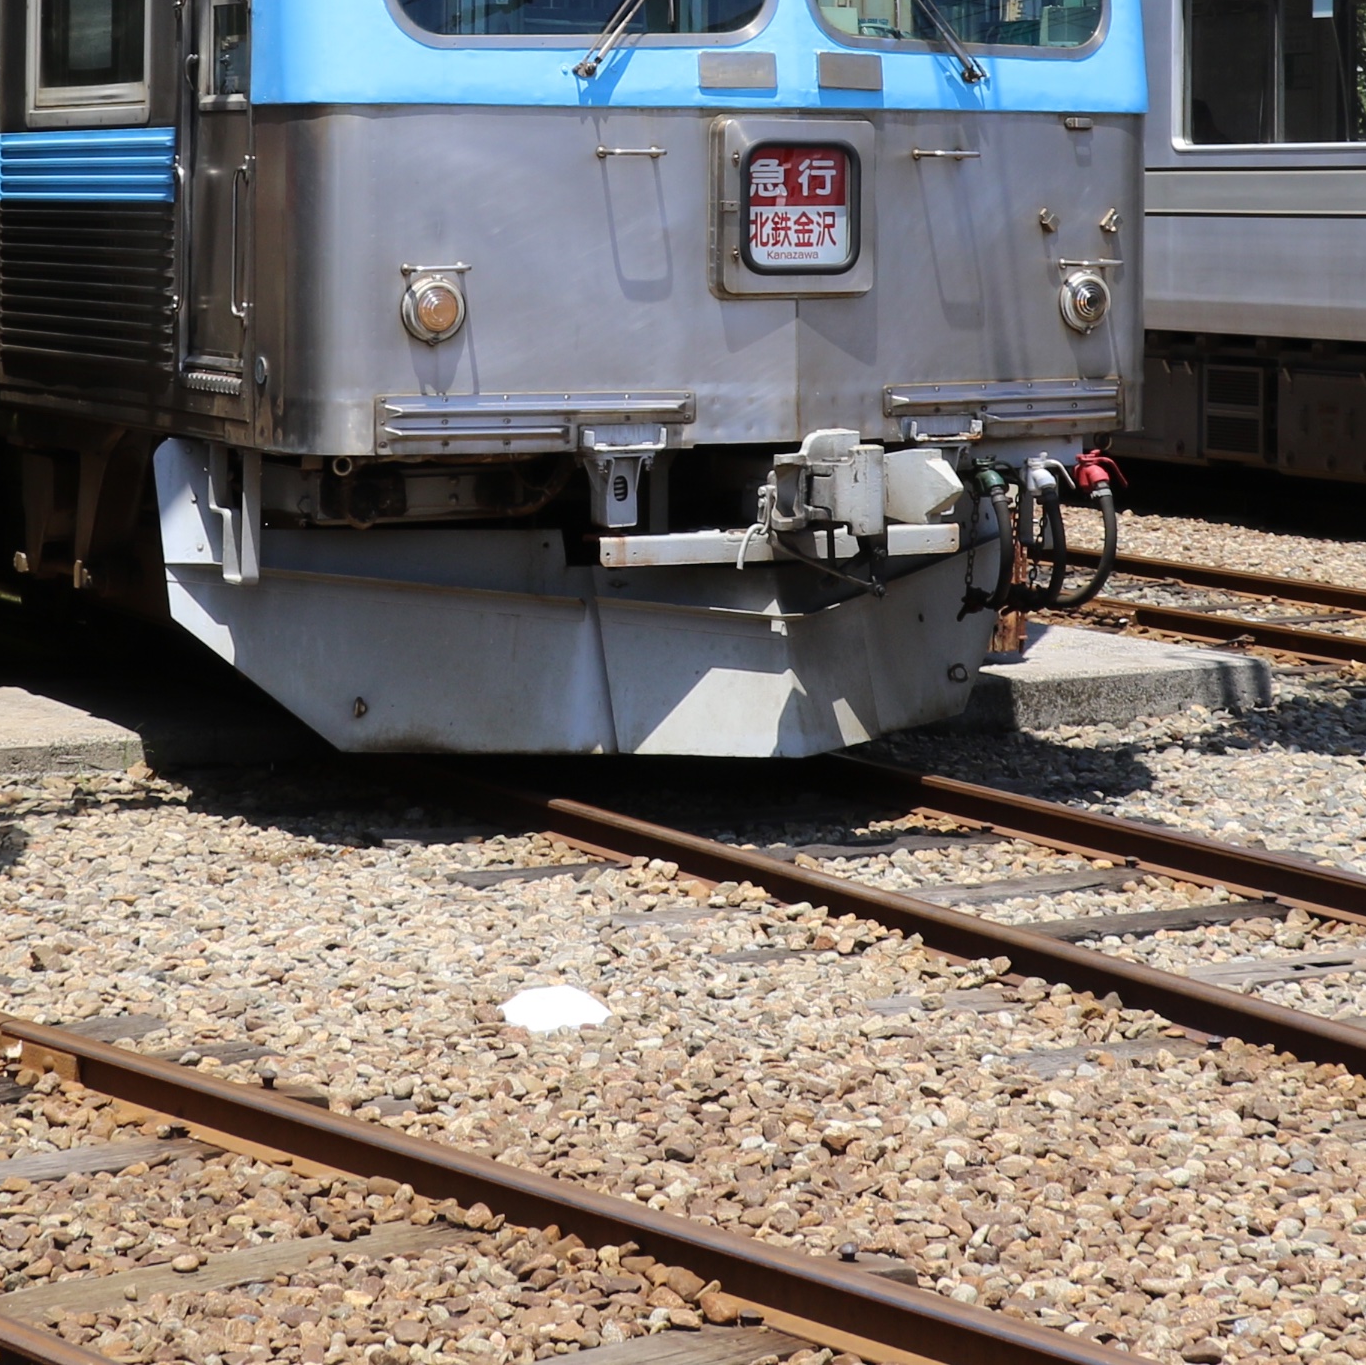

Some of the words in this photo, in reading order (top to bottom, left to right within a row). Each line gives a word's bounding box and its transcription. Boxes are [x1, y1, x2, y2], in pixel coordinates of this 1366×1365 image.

[750, 158, 837, 197] 急行
[750, 211, 837, 248] 北鉄金沢
[767, 250, 819, 260] Kanazawa
